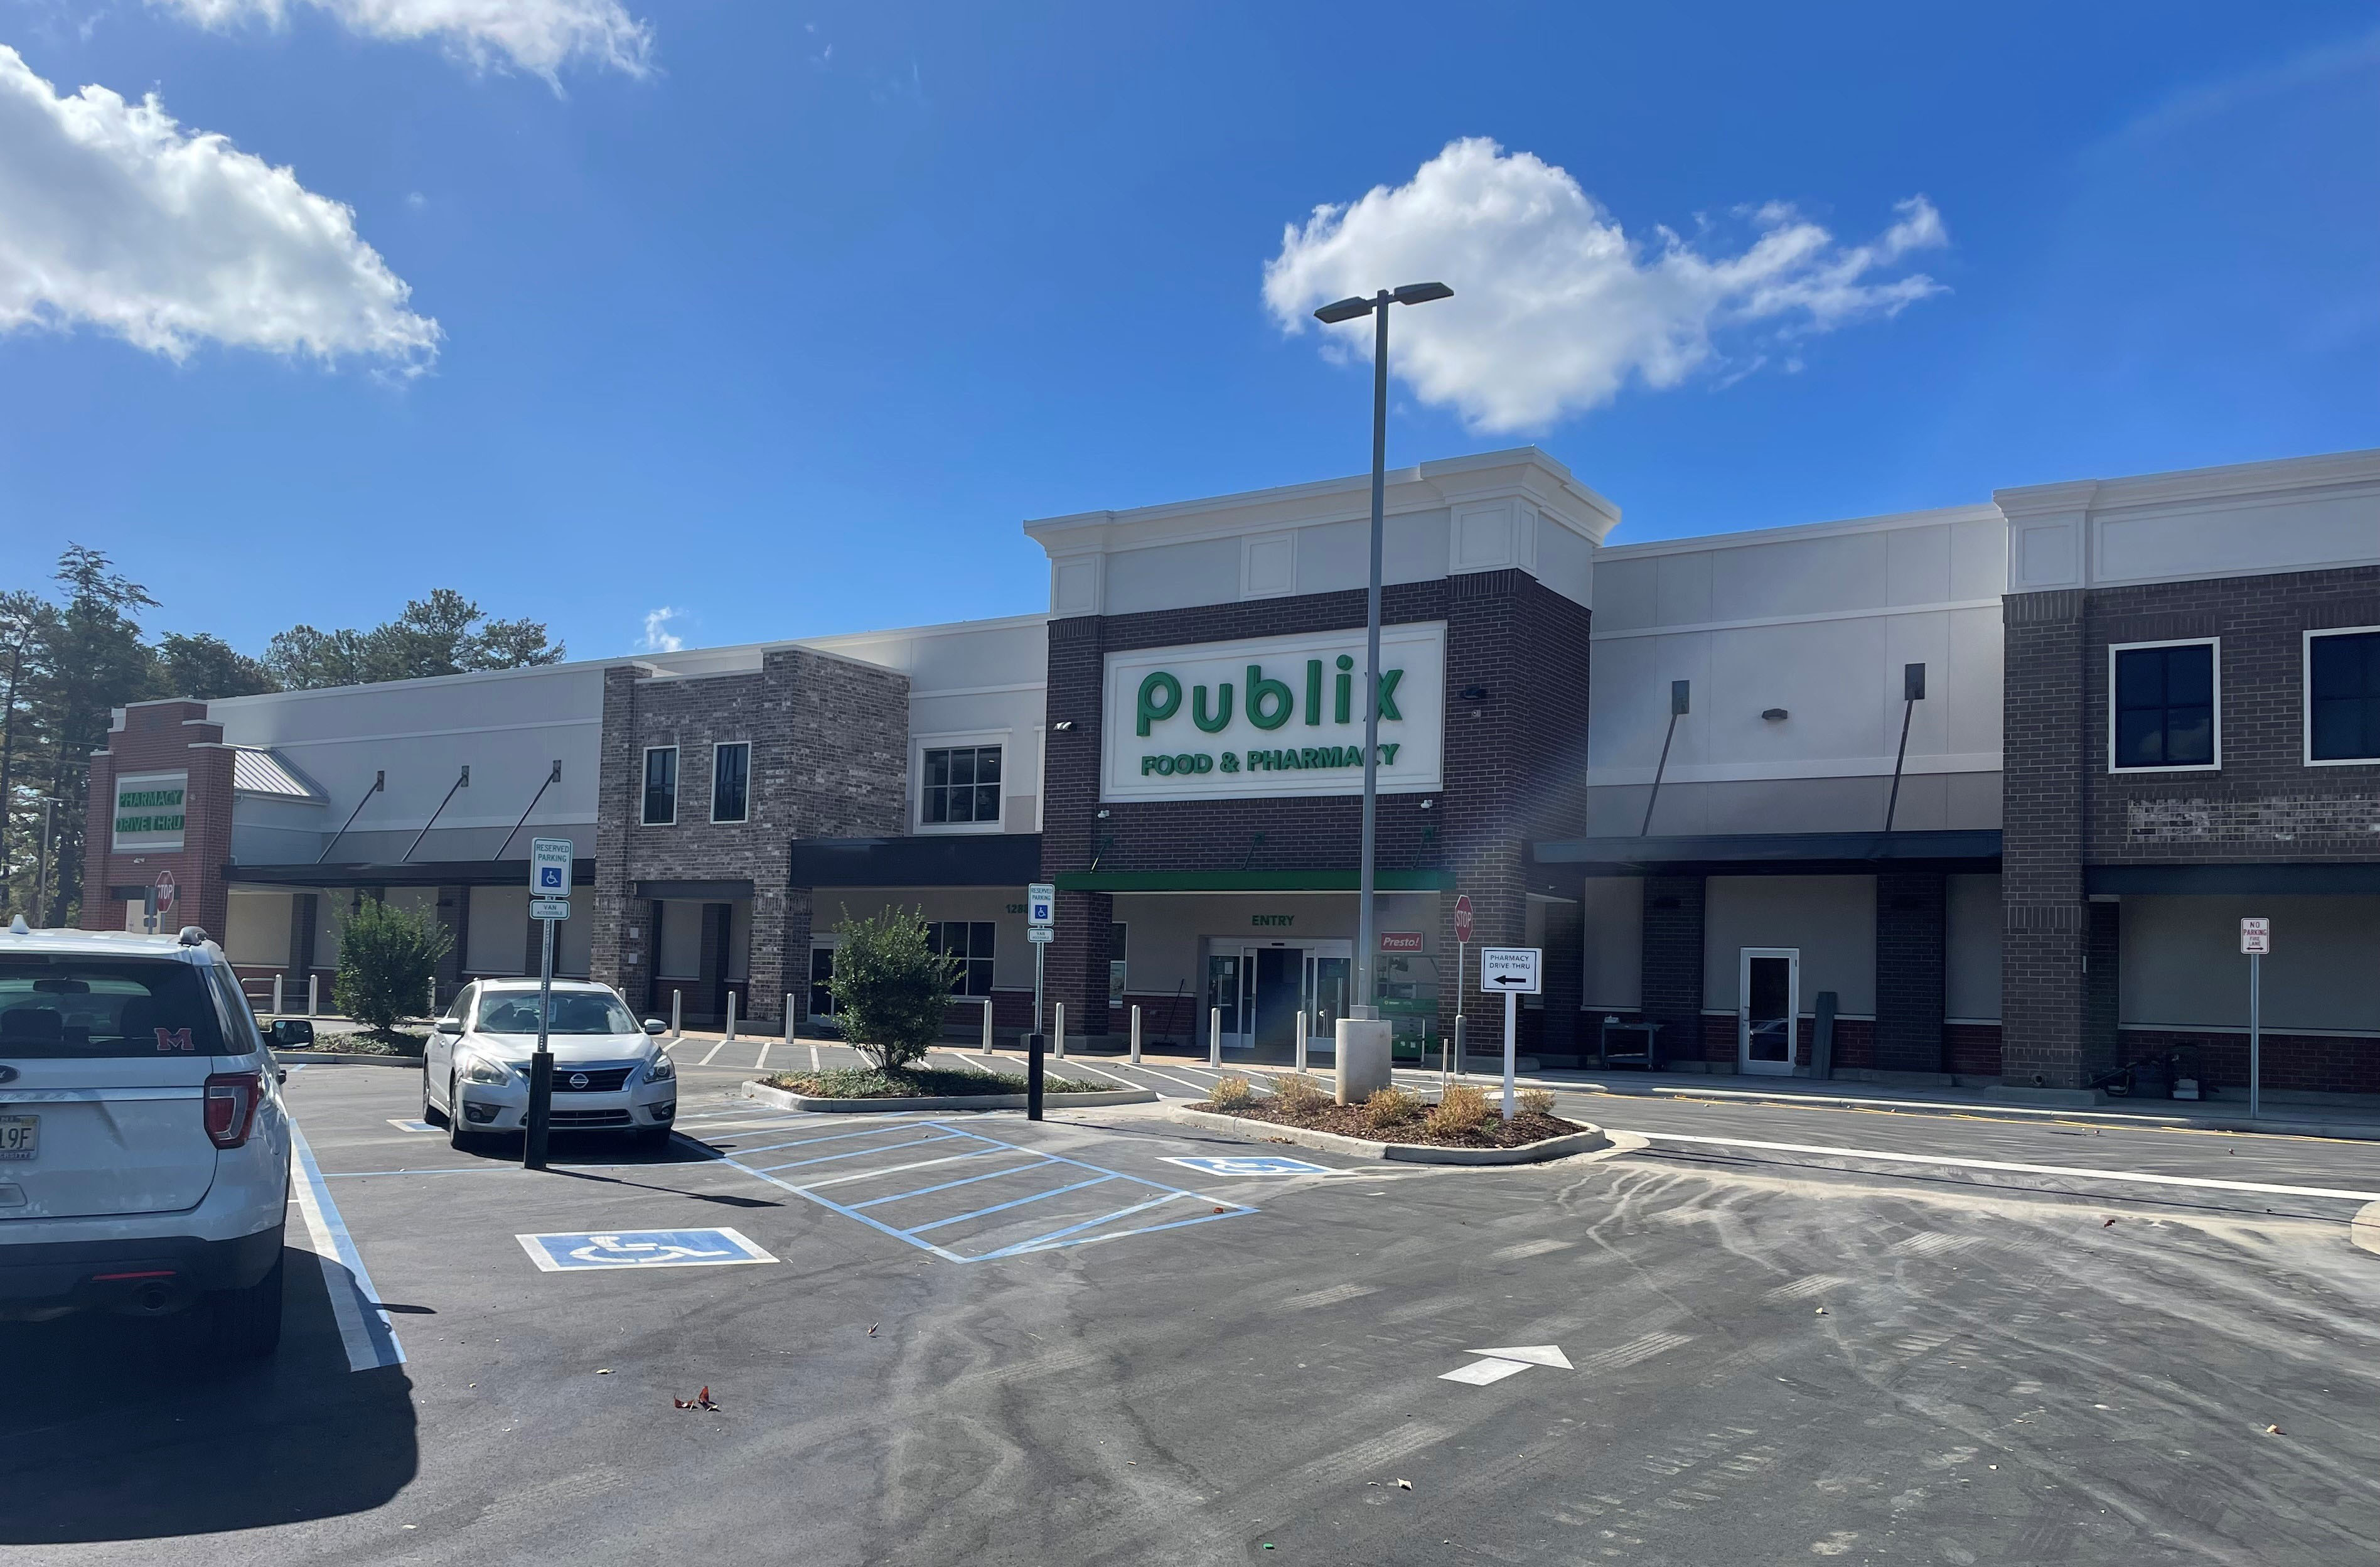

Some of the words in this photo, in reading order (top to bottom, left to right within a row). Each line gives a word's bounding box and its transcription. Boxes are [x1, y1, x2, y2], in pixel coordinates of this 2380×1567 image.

[1137, 654, 1404, 736] Publix
[1141, 753, 1213, 776] FOOD
[1219, 751, 1240, 773] &
[119, 790, 184, 807] PHARMACY
[115, 816, 149, 832] DRIVE
[150, 815, 185, 831] THRU
[536, 844, 569, 853] RESERVED
[538, 854, 567, 863] PARKING
[1252, 915, 1295, 926] ENTRY
[1456, 910, 1472, 928] STOP
[1383, 937, 1420, 947] Presto!
[154, 1028, 195, 1050] M
